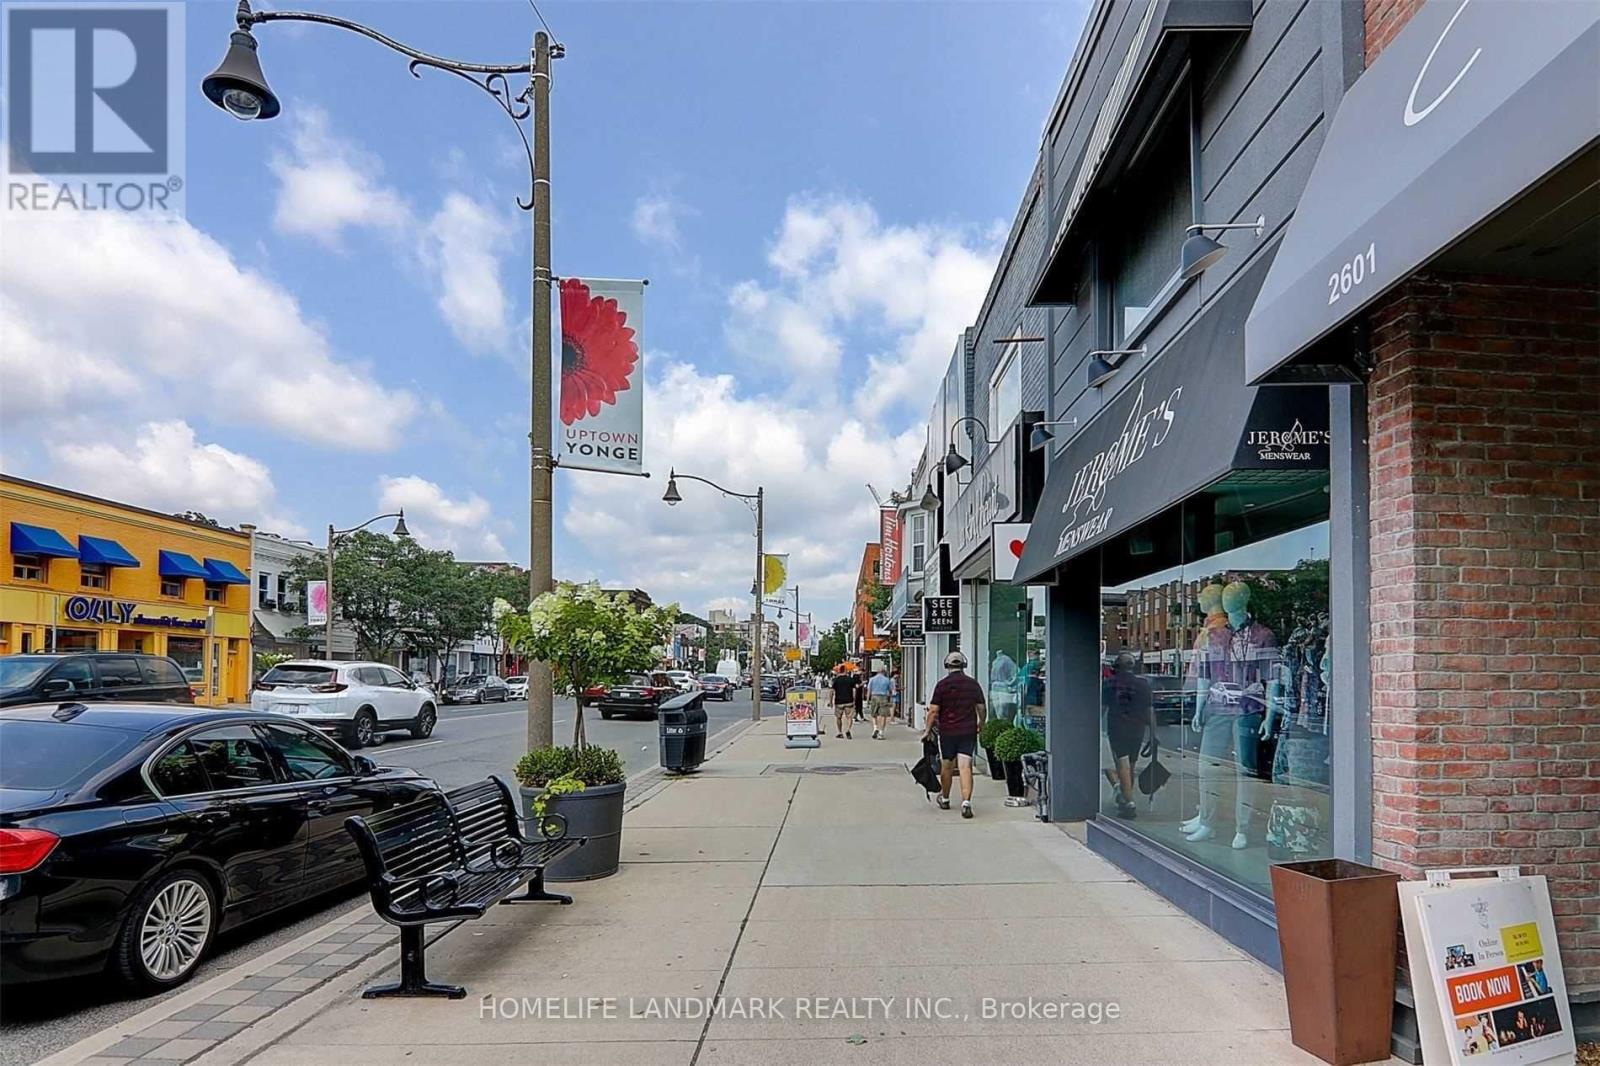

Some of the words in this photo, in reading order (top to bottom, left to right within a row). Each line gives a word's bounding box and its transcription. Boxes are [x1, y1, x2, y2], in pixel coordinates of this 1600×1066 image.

[1328, 242, 1375, 305] 2601
[566, 429, 638, 444] UPTOWN
[1062, 380, 1183, 514] JEROME'S
[566, 442, 638, 460] YONGE
[1259, 452, 1311, 460] MENSWEAR
[1054, 507, 1113, 557] MENSWEAR
[65, 596, 137, 624] OLLY
[931, 599, 953, 608] SEE
[931, 609, 938, 617] &
[941, 609, 953, 617] BE
[1454, 980, 1486, 1004] BOOK
[1486, 975, 1511, 997] NOW
